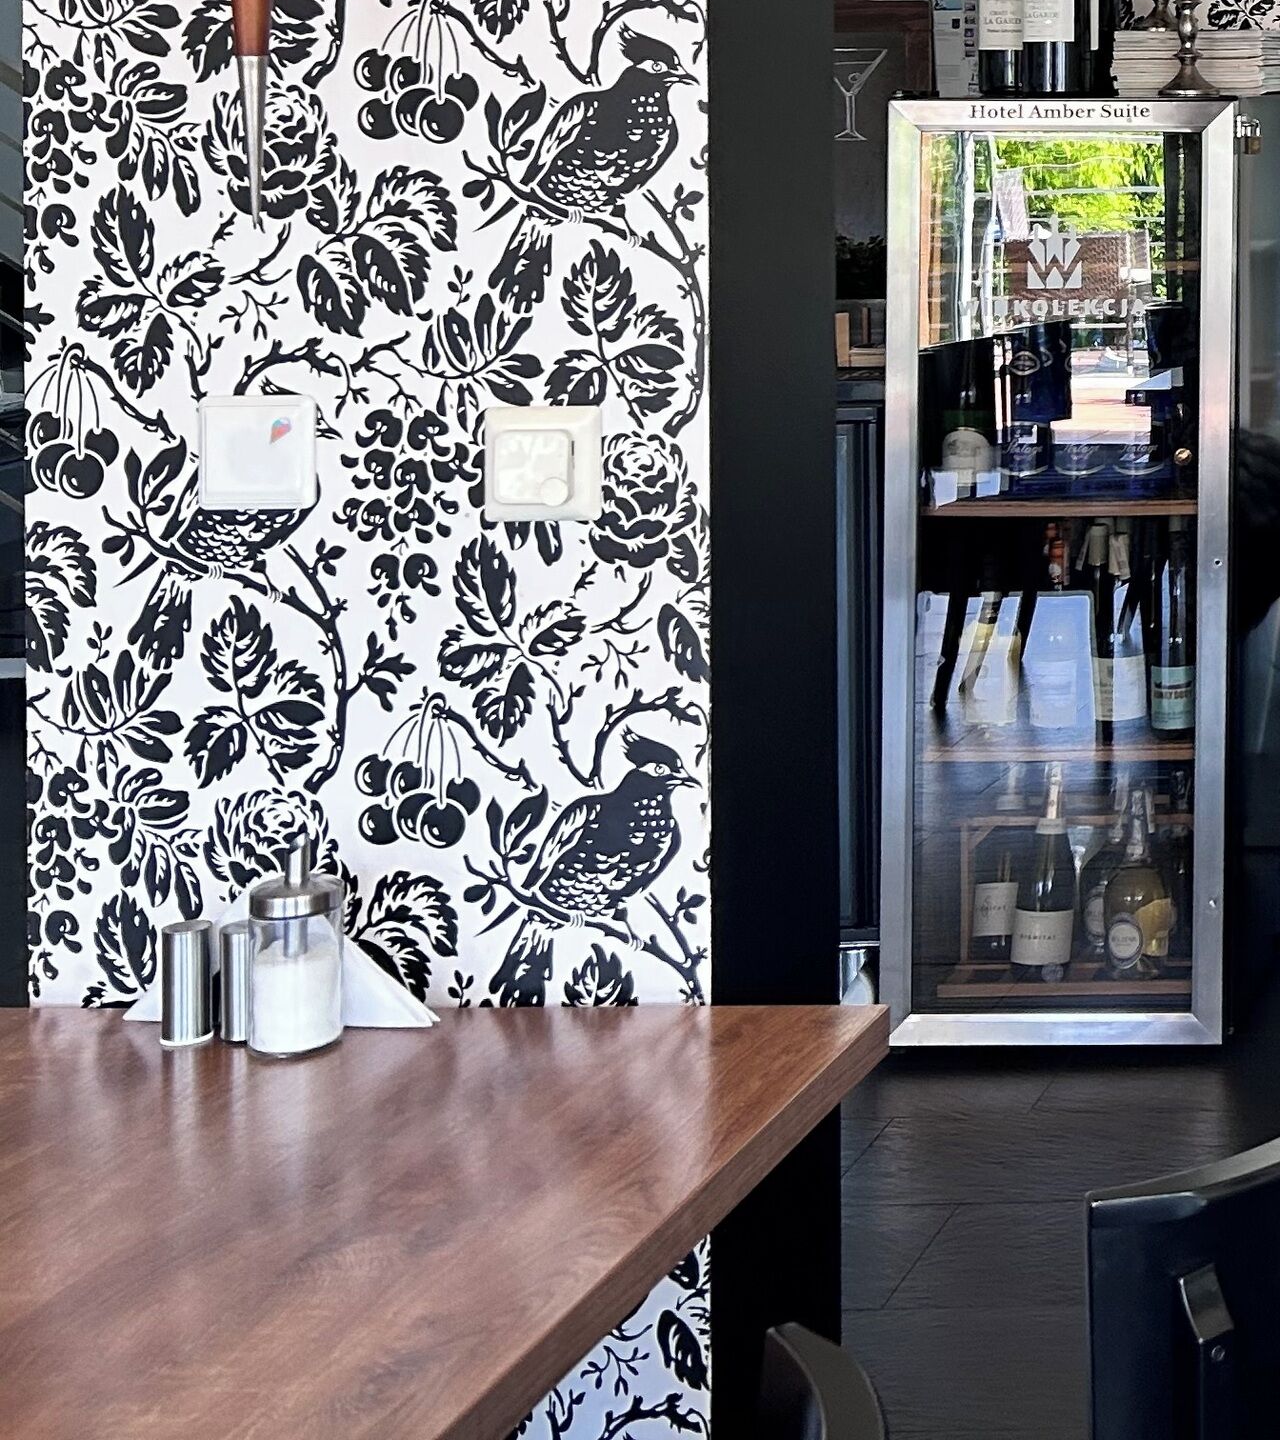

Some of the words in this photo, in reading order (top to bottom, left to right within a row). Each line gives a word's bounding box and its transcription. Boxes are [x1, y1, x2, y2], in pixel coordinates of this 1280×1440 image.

[995, 16, 1022, 25] GARD
[969, 104, 1024, 119] Hotel
[1028, 104, 1096, 119] Amber
[1099, 104, 1151, 119] Suite
